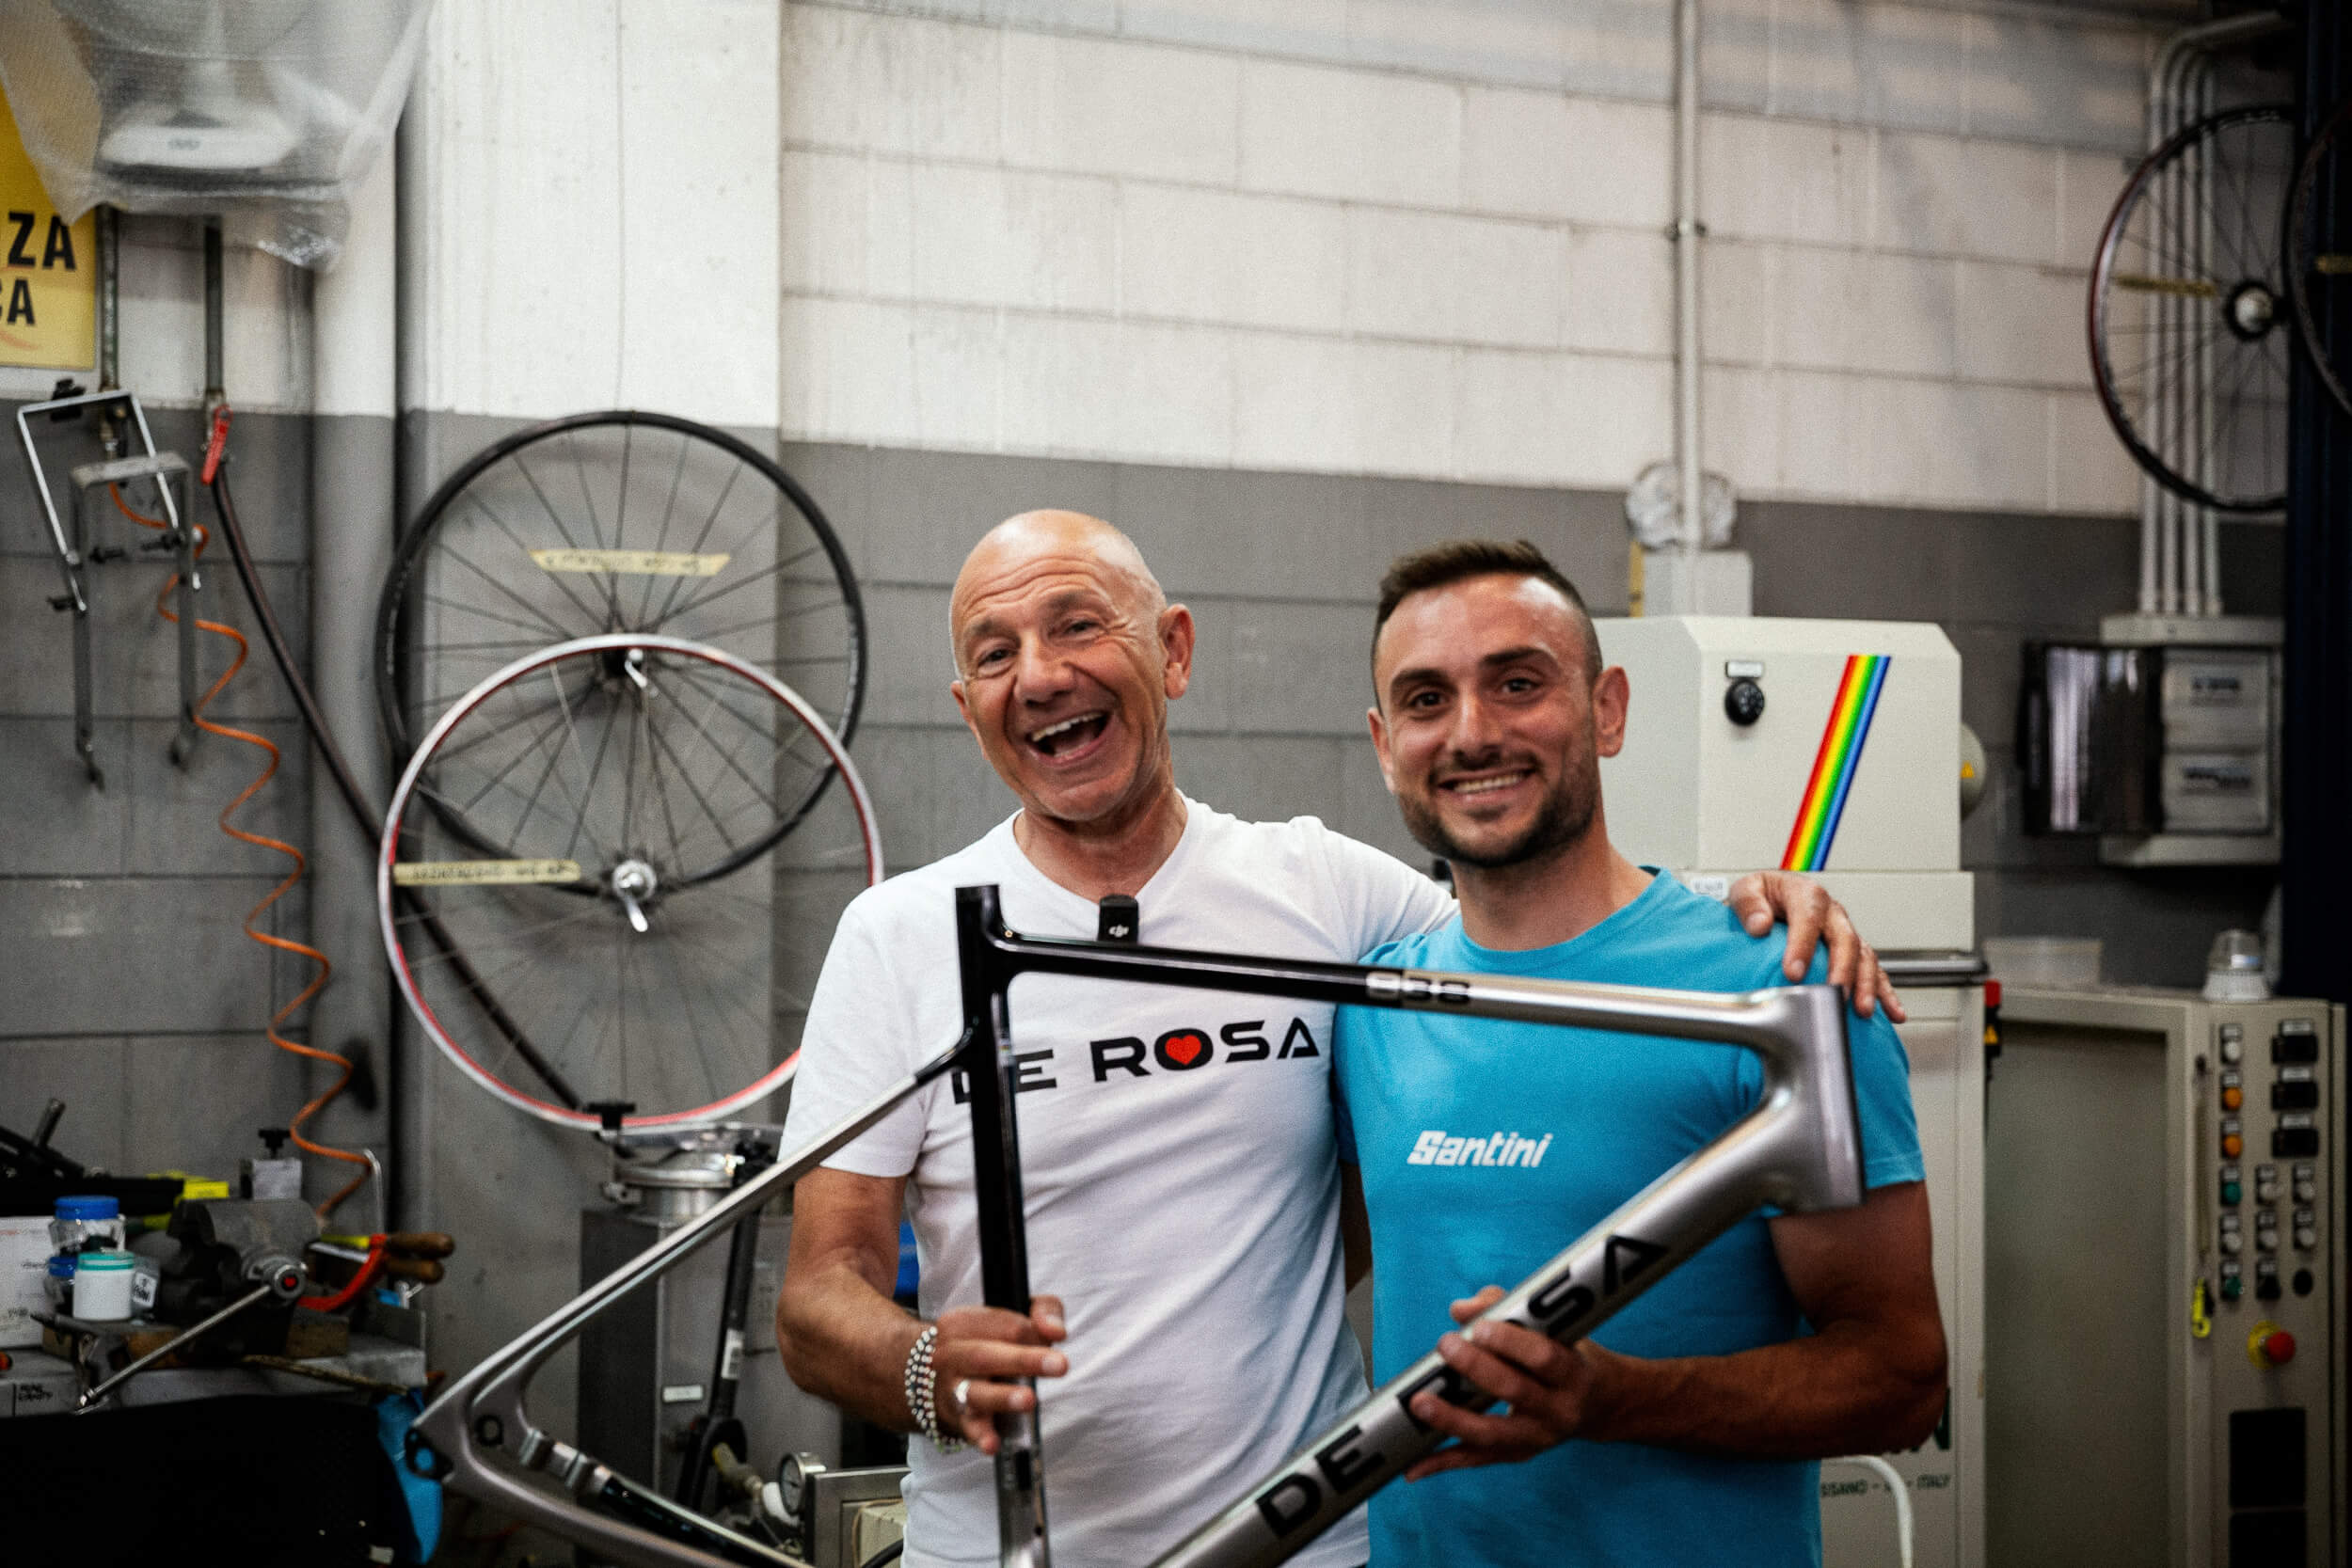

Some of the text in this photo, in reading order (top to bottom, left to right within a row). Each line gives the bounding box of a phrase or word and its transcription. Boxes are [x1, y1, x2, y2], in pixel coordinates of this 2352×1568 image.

[1089, 1017, 1320, 1083] ROSA
[1406, 1130, 1553, 1168] Santini
[1255, 1234, 1670, 1539] DE RSA
